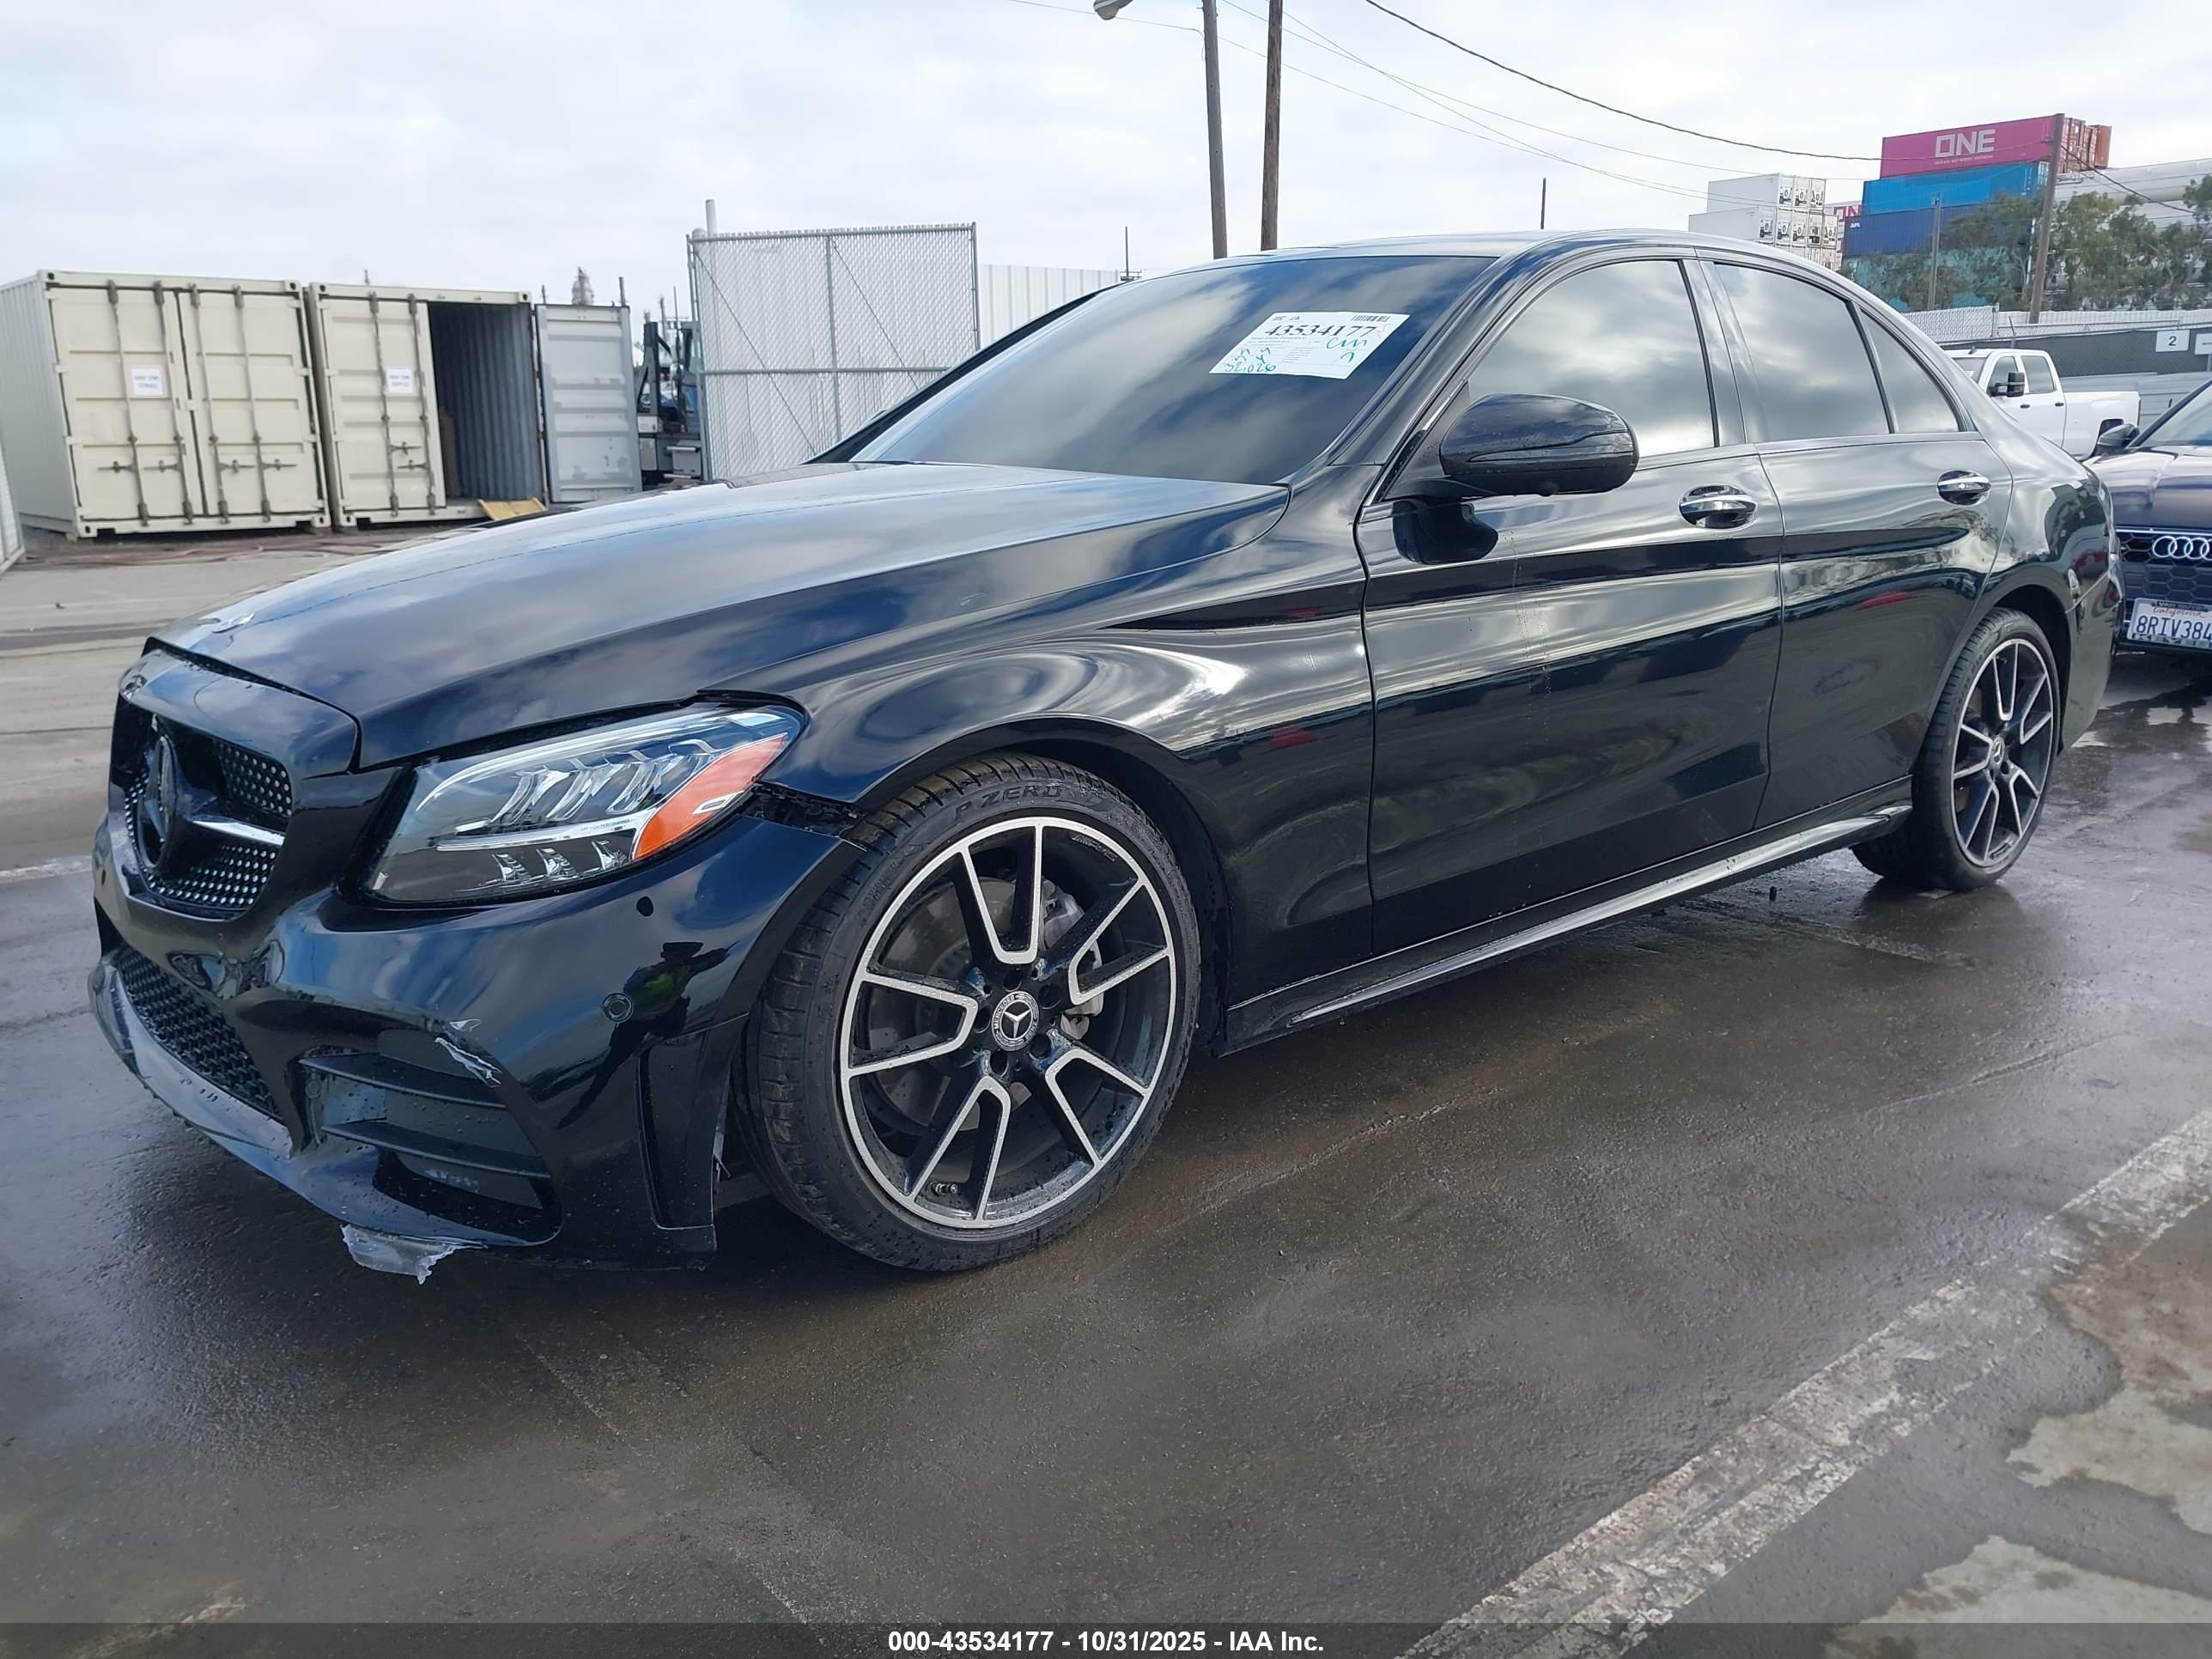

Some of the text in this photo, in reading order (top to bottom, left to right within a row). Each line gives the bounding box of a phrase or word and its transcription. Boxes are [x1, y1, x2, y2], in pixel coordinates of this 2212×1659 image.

[1936, 129, 1996, 157] ONE
[1265, 325, 1377, 337] 43534177
[2168, 335, 2177, 346] 2
[955, 785, 1063, 821] P ZERO
